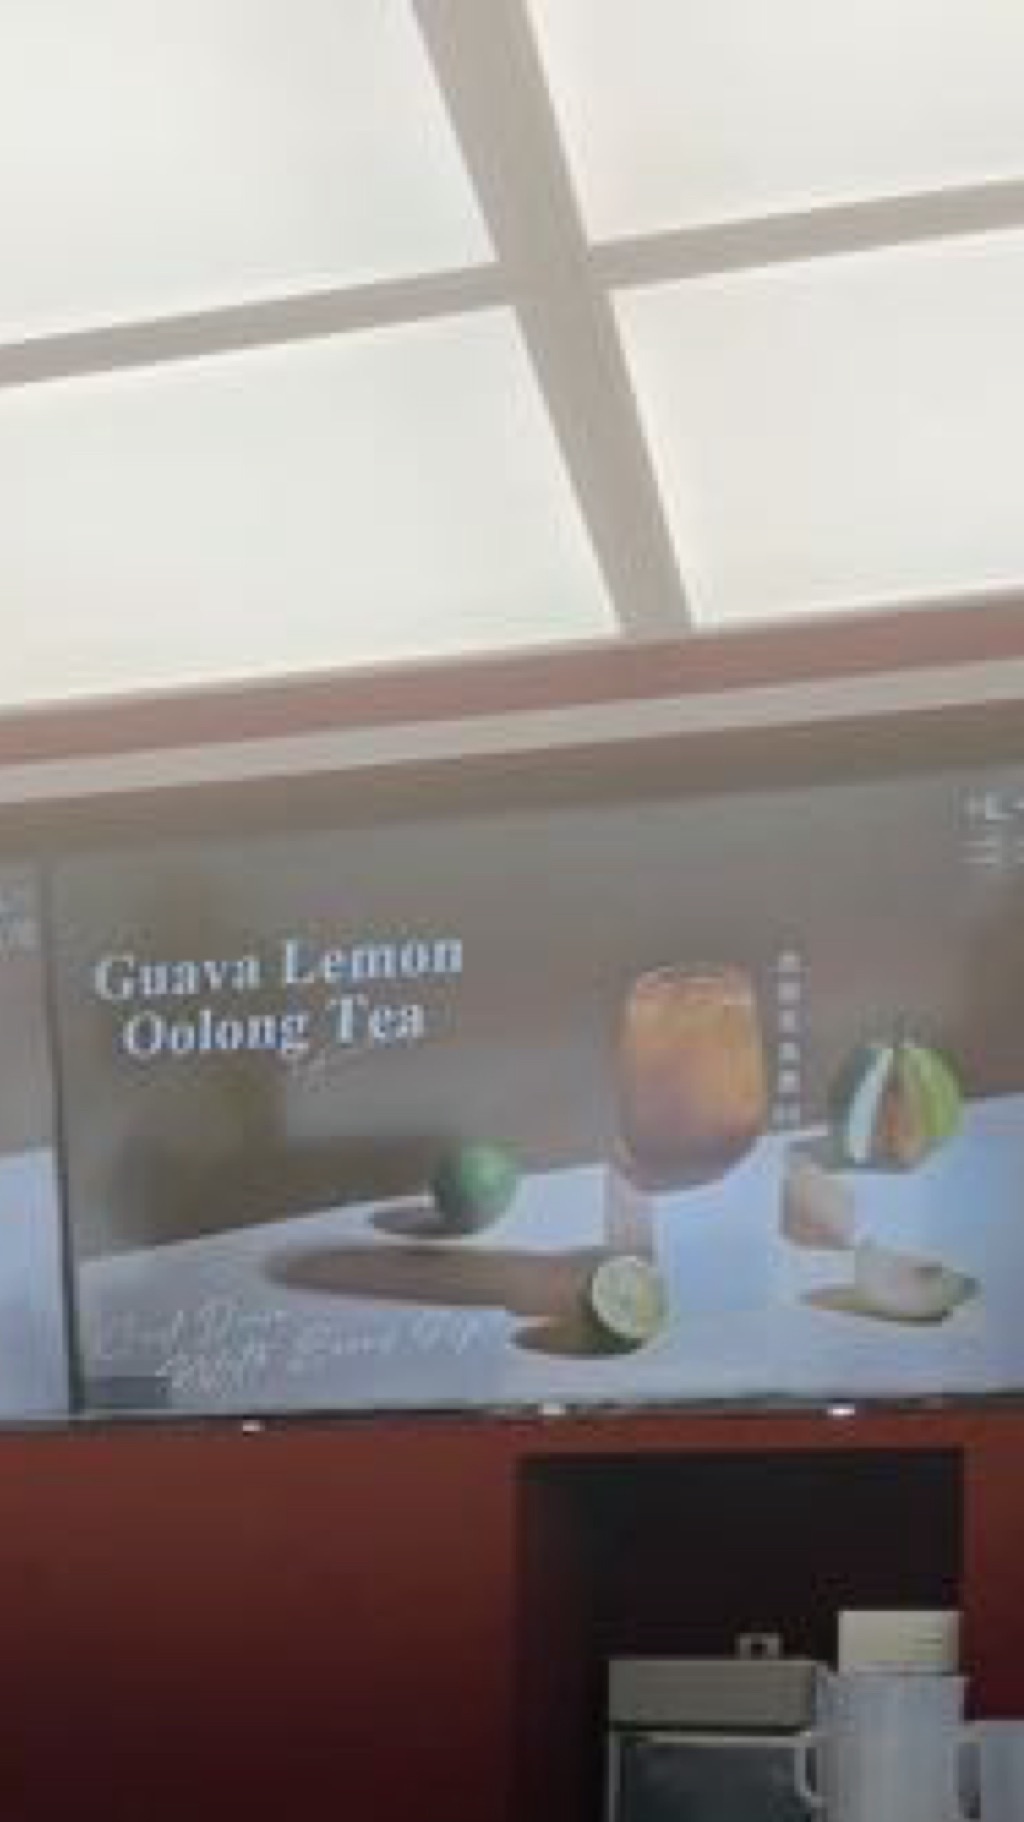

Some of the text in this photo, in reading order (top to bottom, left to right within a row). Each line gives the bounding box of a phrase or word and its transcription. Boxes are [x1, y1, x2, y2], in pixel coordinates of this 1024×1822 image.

[93, 938, 463, 999] Guava Lemon
[122, 993, 425, 1061] Oolong Tea
